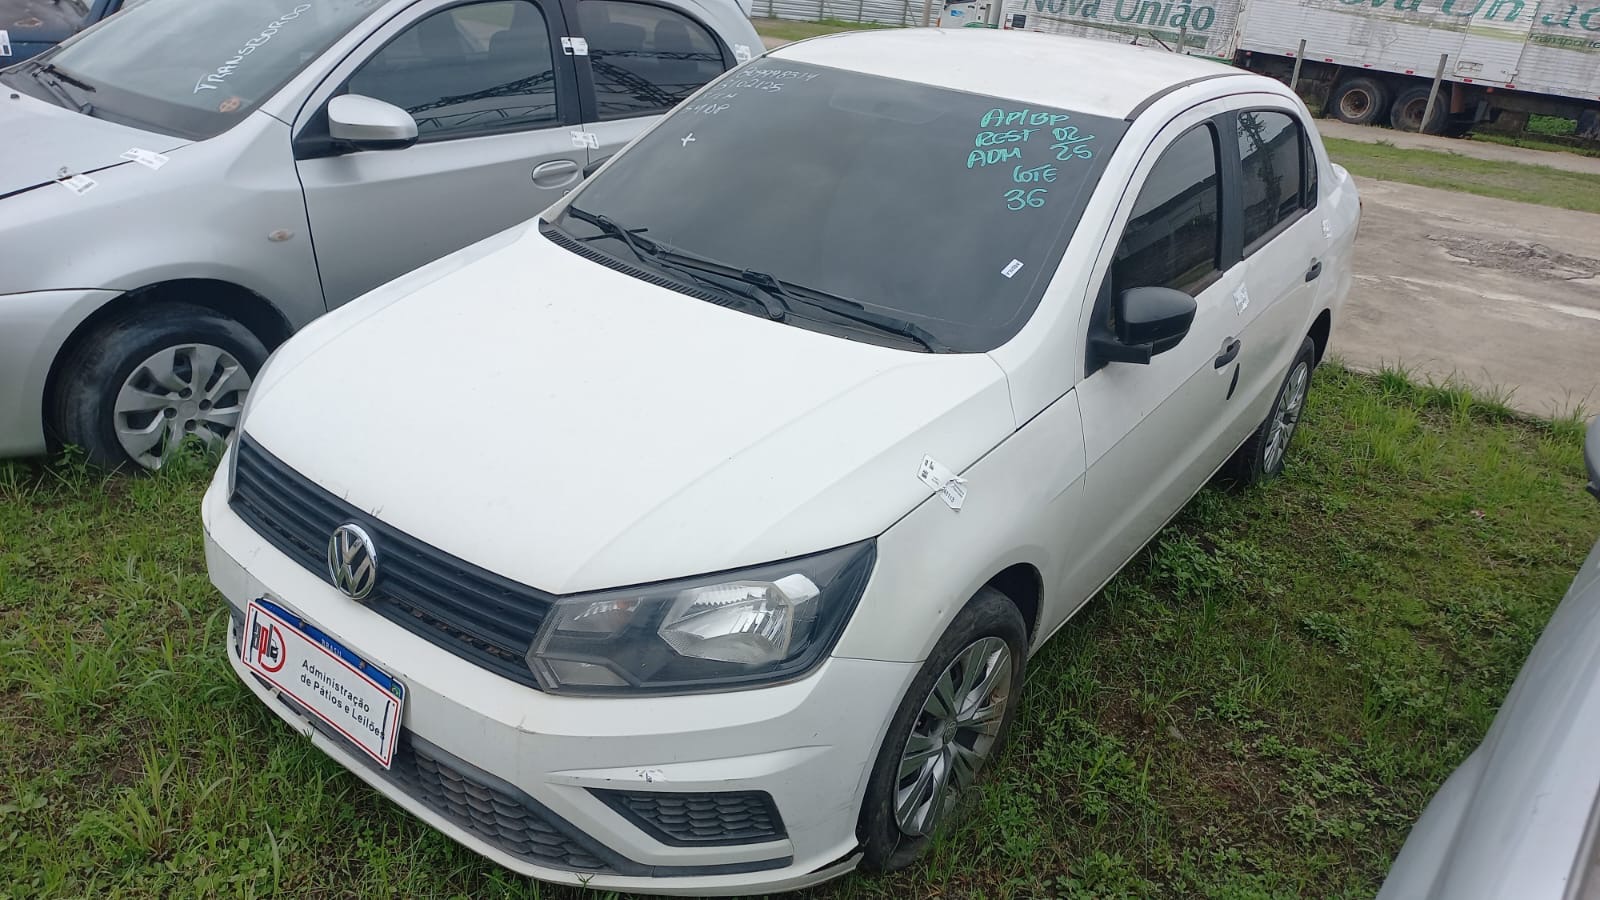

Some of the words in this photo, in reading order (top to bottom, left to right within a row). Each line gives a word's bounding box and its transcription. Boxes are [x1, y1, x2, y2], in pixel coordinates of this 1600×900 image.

[1113, 0, 1216, 31] União
[193, 3, 311, 94] TRANSBORDO
[967, 147, 1022, 169] ADM
[1003, 188, 1048, 211] 36
[300, 673, 312, 687] de
[313, 680, 343, 709] Pátios
[344, 705, 351, 714] e
[301, 659, 370, 713] Administração
